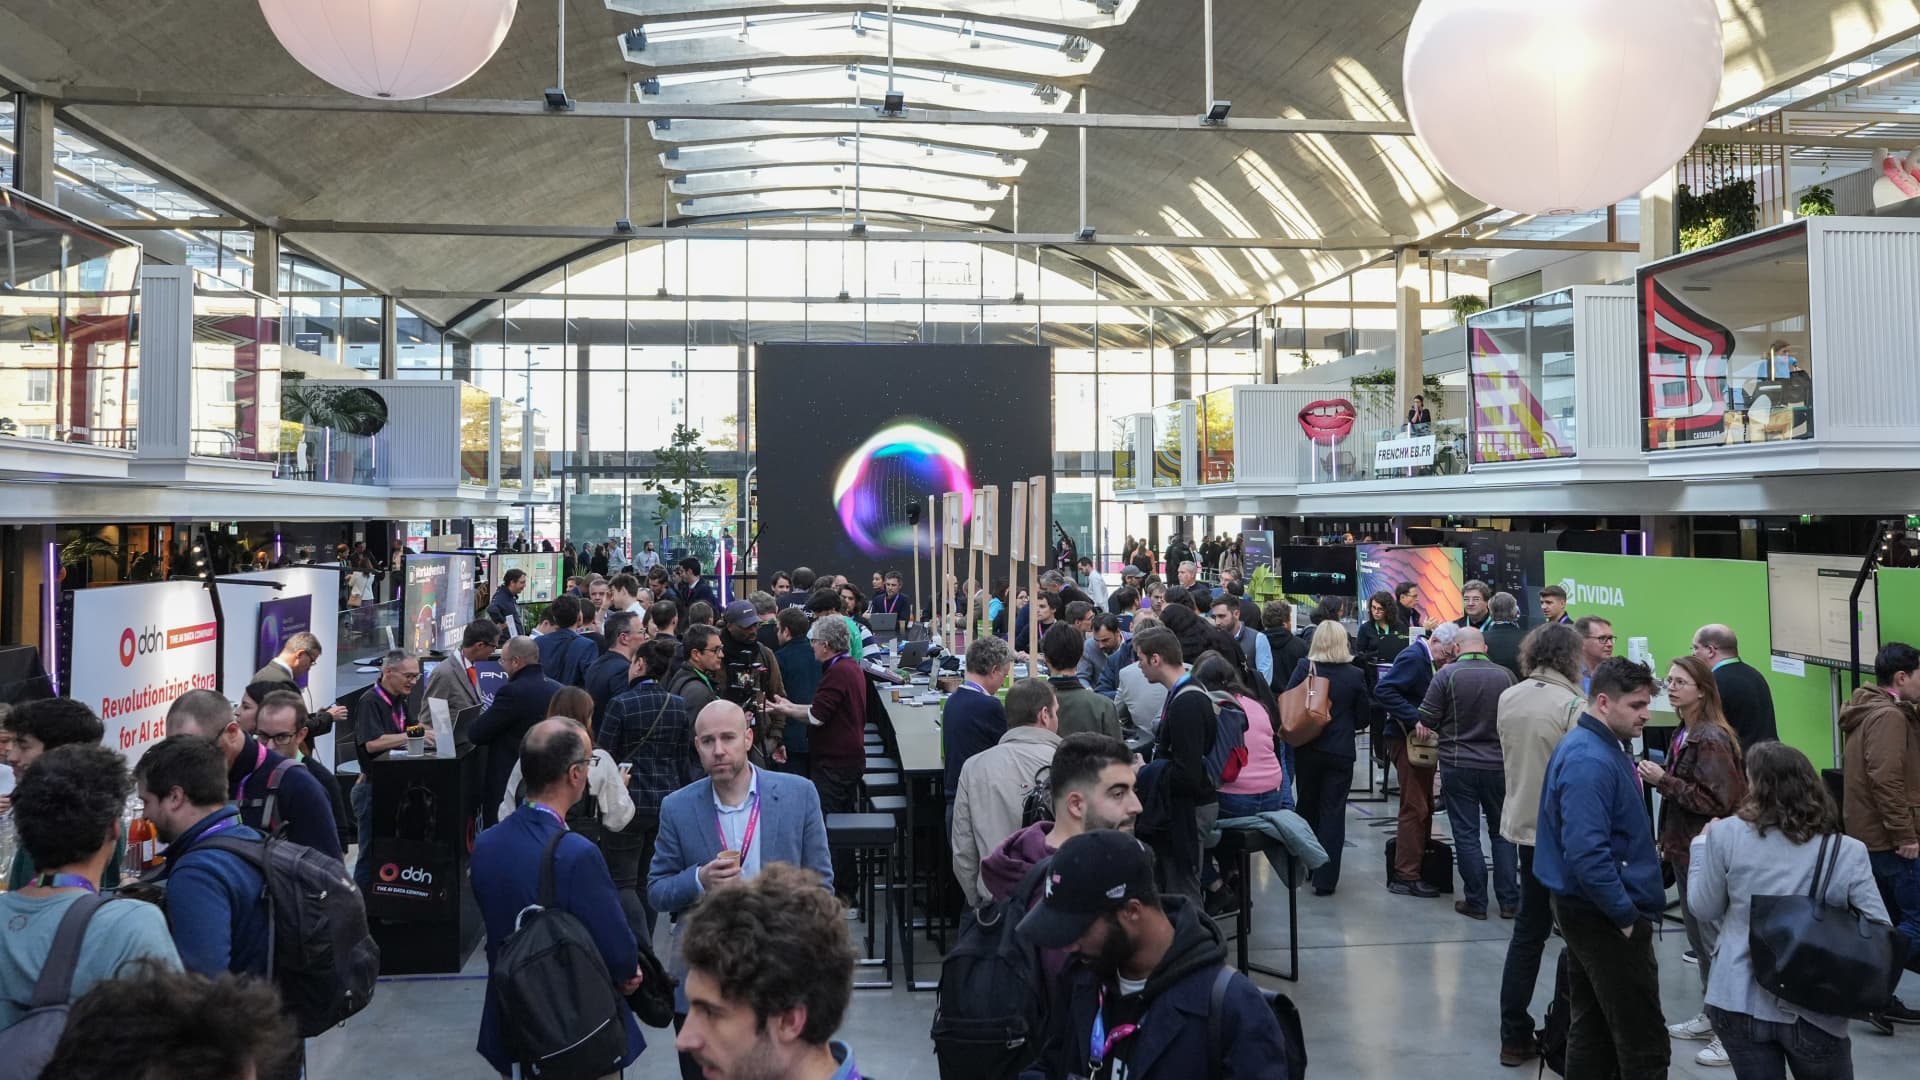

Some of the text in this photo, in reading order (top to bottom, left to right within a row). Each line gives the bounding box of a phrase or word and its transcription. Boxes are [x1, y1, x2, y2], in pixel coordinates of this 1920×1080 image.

[138, 624, 164, 655] ddn
[191, 673, 215, 691] Stora
[102, 676, 190, 720] Revolutionizing
[119, 719, 164, 750] for AI at
[401, 866, 433, 884] ddn
[406, 889, 429, 897] COMPANY
